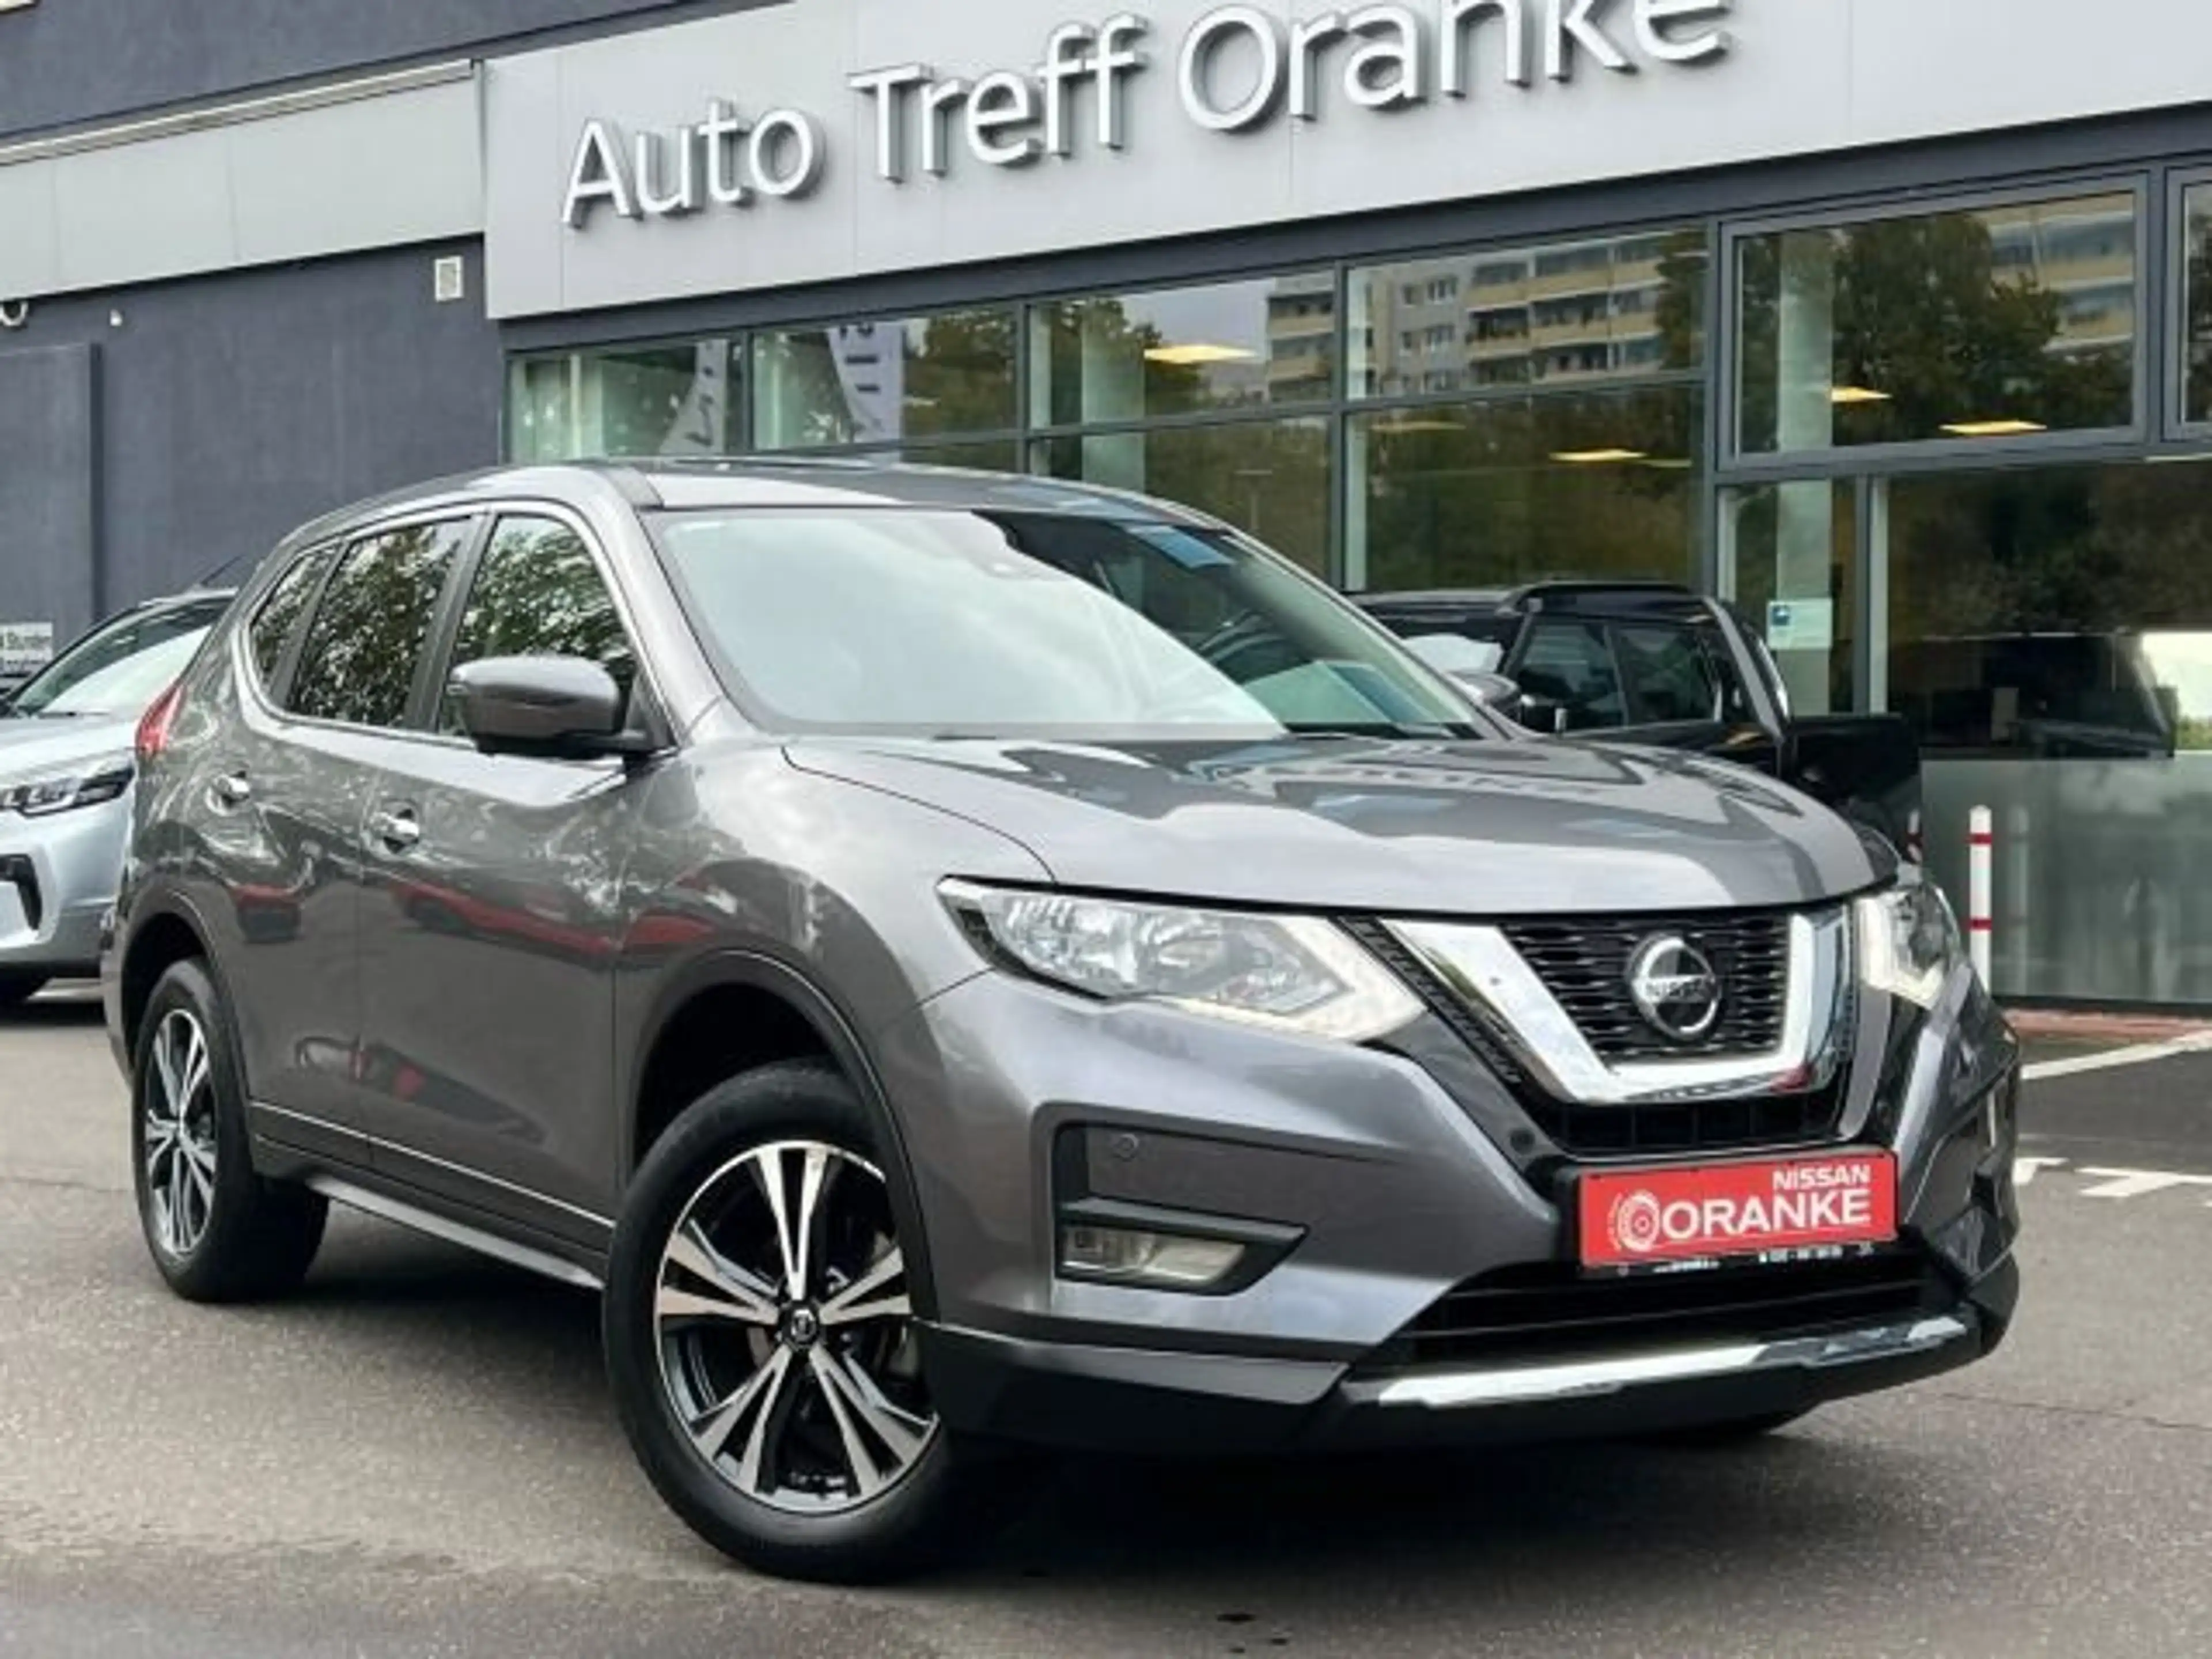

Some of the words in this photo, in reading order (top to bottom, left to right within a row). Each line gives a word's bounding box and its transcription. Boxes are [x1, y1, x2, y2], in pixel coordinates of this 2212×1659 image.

[562, 98, 824, 227] Auto
[847, 14, 1146, 183] Treff
[1177, 0, 1729, 131] Oranke
[1772, 1164, 1871, 1190] NISSAN
[1662, 1188, 1871, 1240] ORANKE
